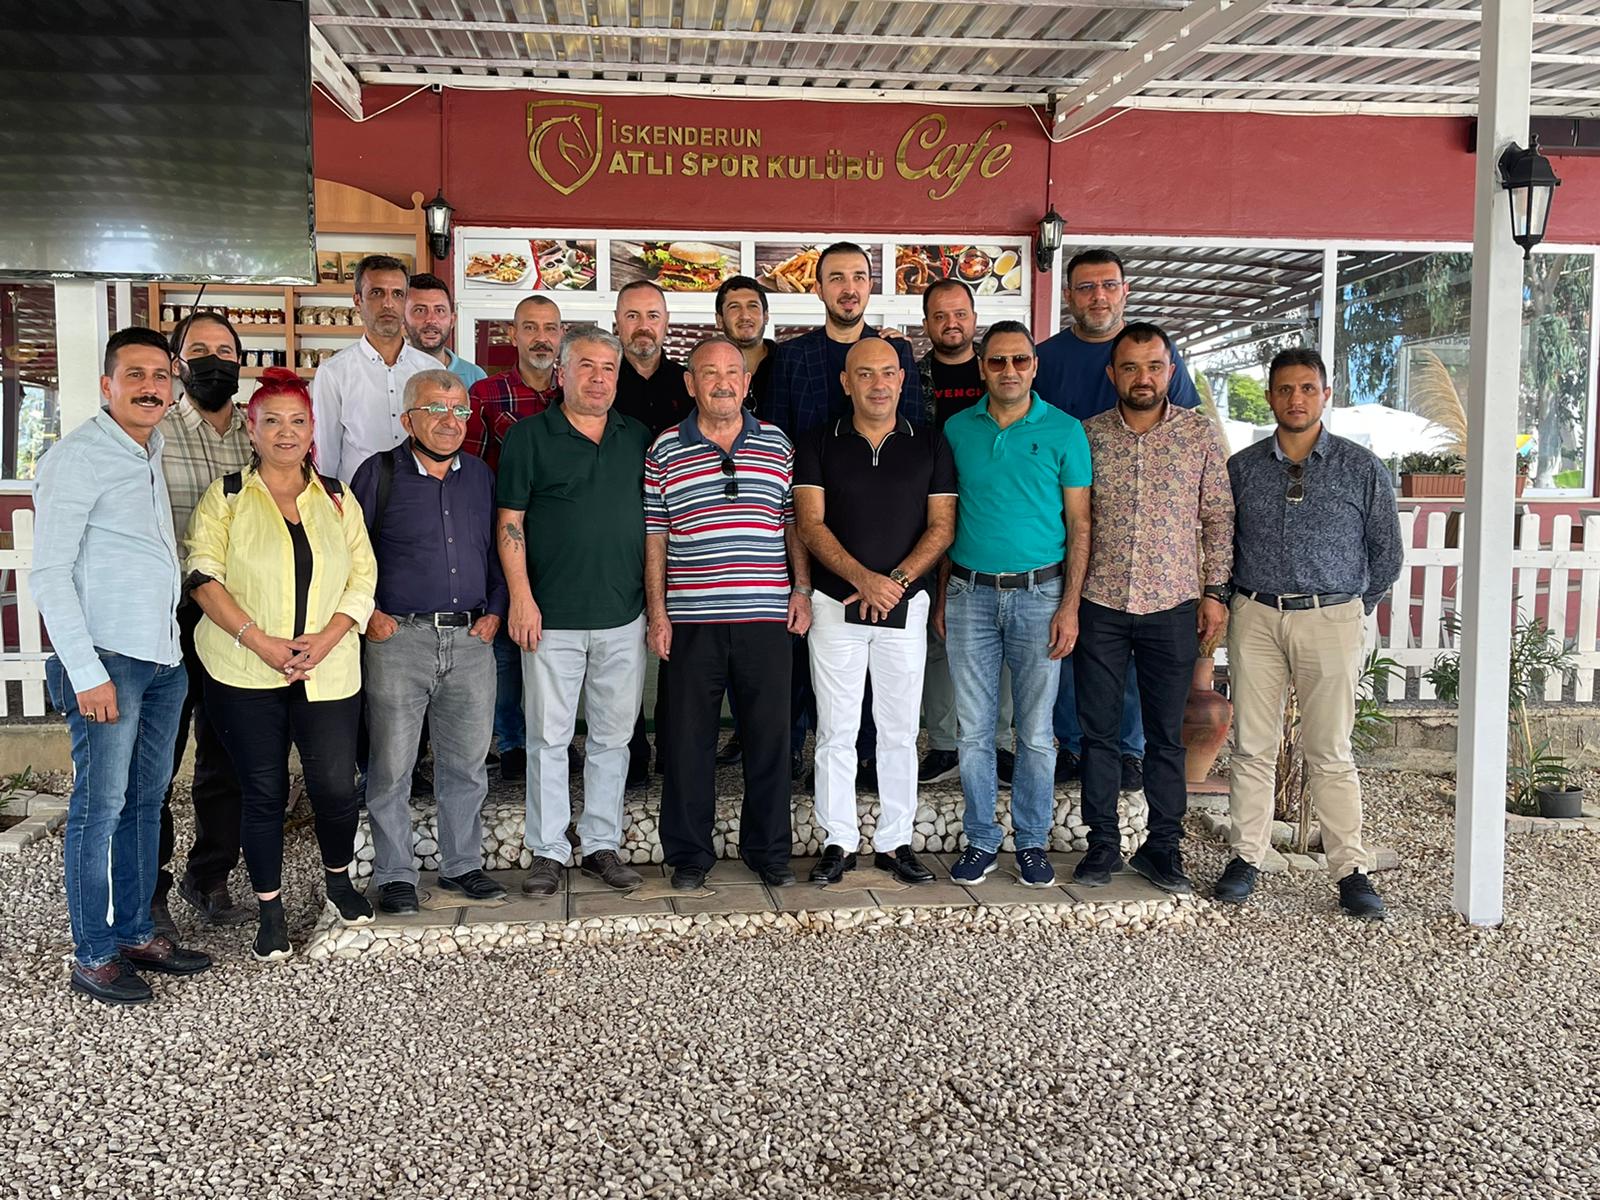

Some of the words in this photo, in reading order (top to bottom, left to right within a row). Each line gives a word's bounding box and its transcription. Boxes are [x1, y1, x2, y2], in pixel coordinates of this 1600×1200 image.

[610, 119, 763, 147] İSKENDERUN
[608, 150, 674, 176] ATLI
[680, 150, 760, 178] SPOR
[895, 112, 1013, 201] Cafe
